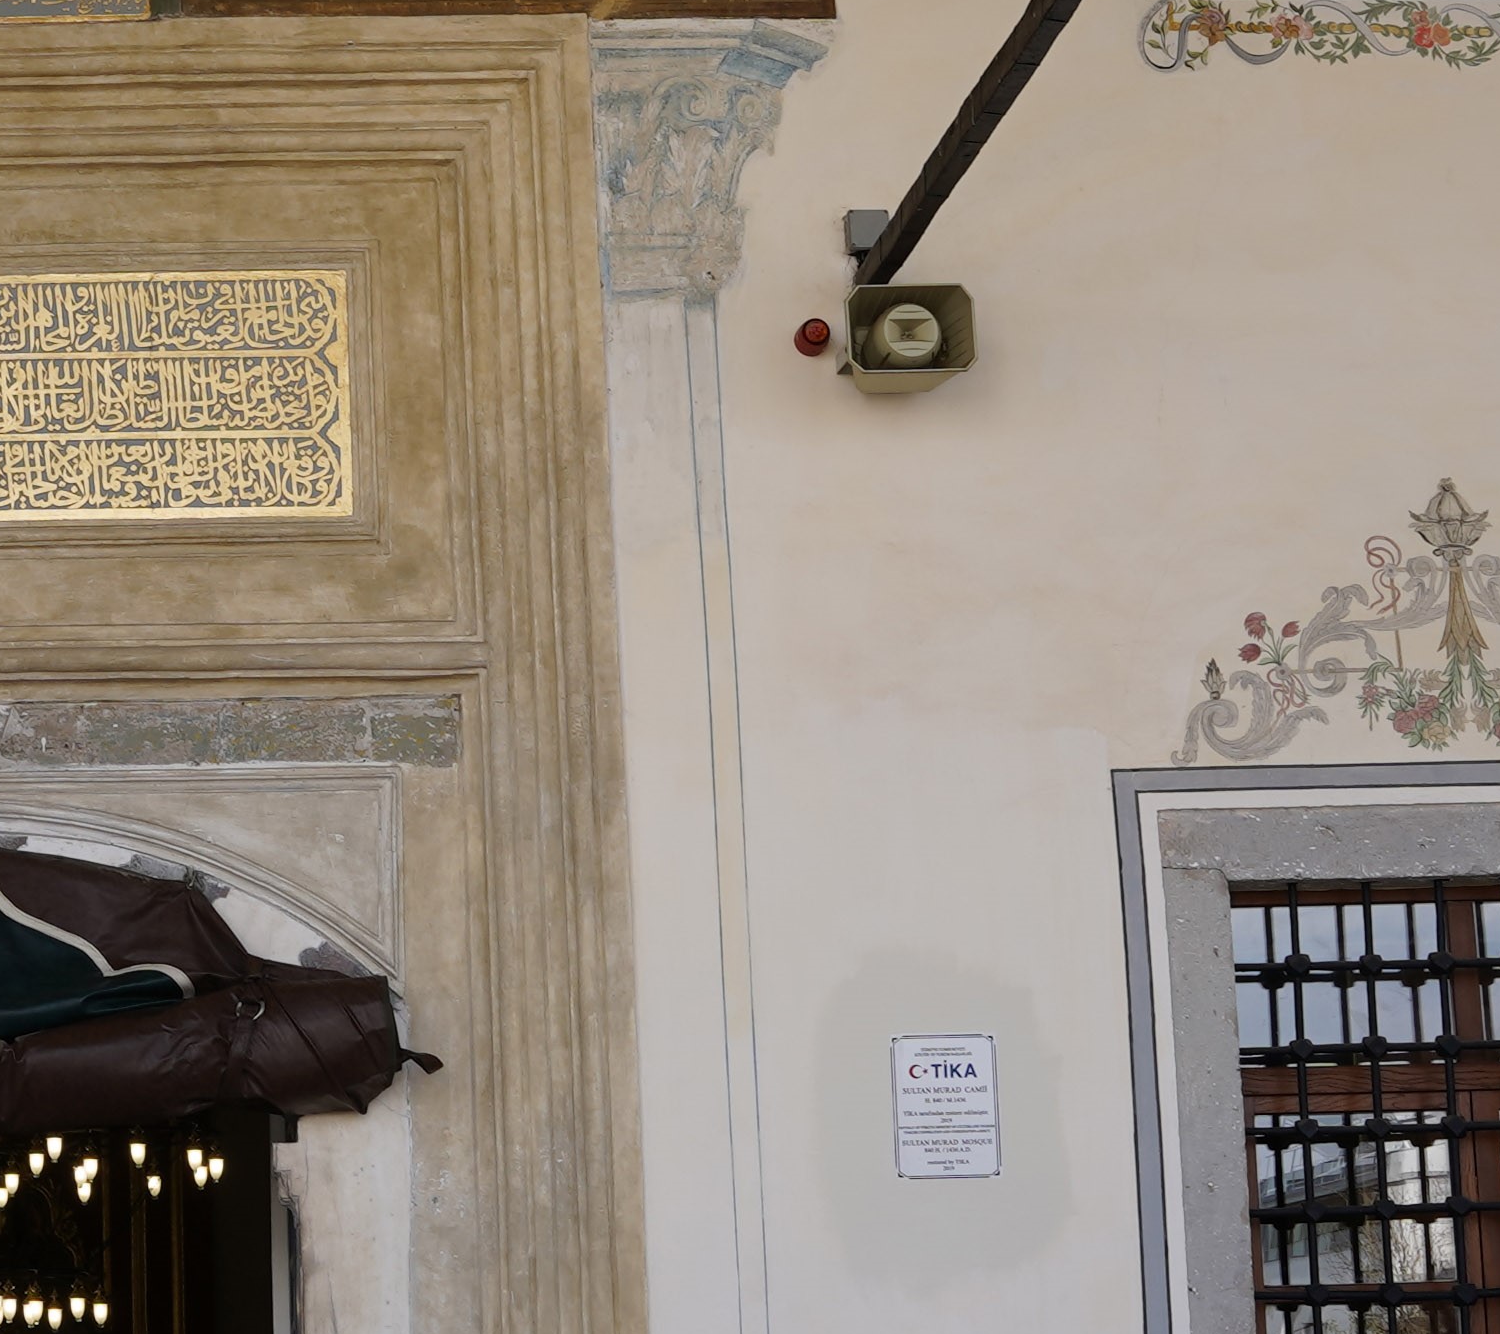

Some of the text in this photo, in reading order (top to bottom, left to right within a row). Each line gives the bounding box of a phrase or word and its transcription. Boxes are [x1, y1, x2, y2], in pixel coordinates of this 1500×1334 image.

[930, 1059, 978, 1079] TİKA
[902, 1087, 931, 1095] SULTAN
[933, 1086, 962, 1094] MURAD
[901, 1139, 930, 1147] SULTAN
[961, 1138, 993, 1146] MOSQUE
